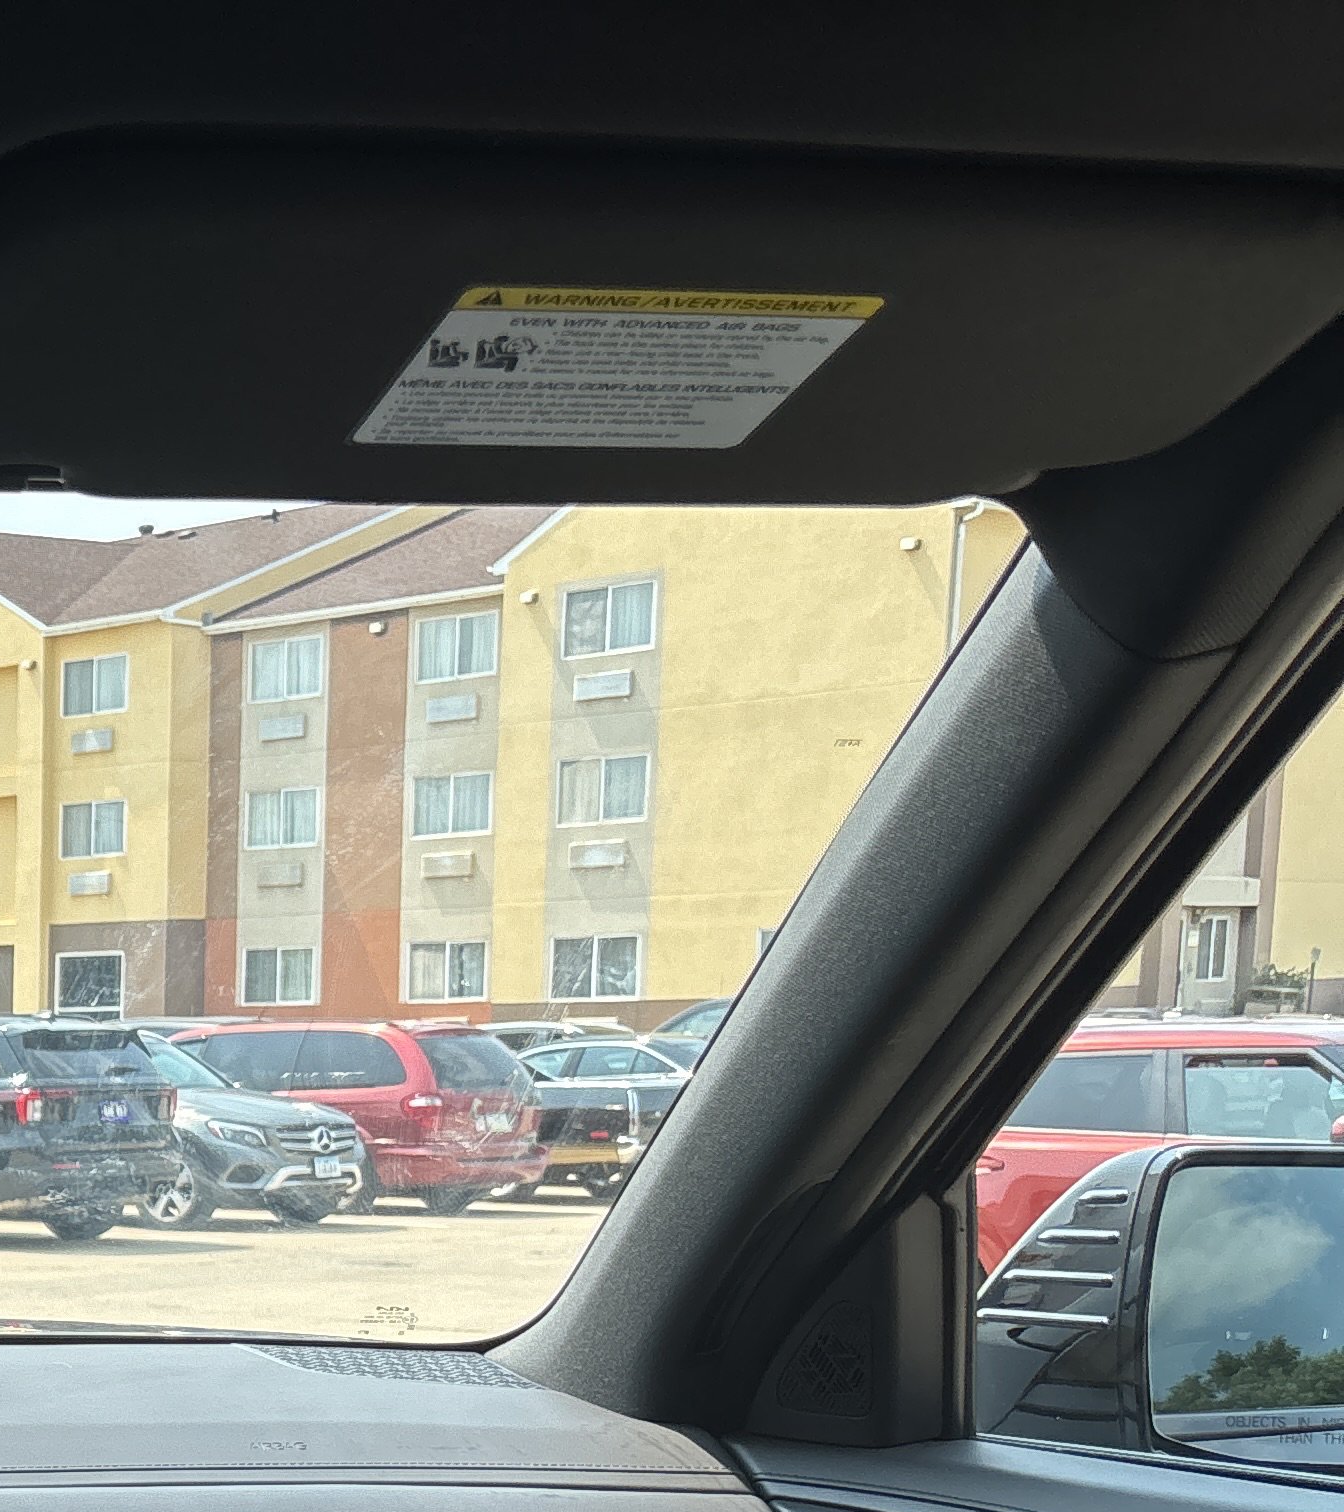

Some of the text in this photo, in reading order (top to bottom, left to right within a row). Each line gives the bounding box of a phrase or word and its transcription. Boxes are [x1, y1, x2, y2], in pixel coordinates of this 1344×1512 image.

[509, 317, 557, 328] EVEN
[563, 318, 608, 329] WITH
[613, 319, 710, 331] ADVANCED
[751, 322, 802, 332] BAGS
[449, 379, 494, 389] AVEC
[1225, 1415, 1287, 1428] OBJECTS
[1297, 1416, 1310, 1427] IN
[1279, 1432, 1312, 1445] THAN
